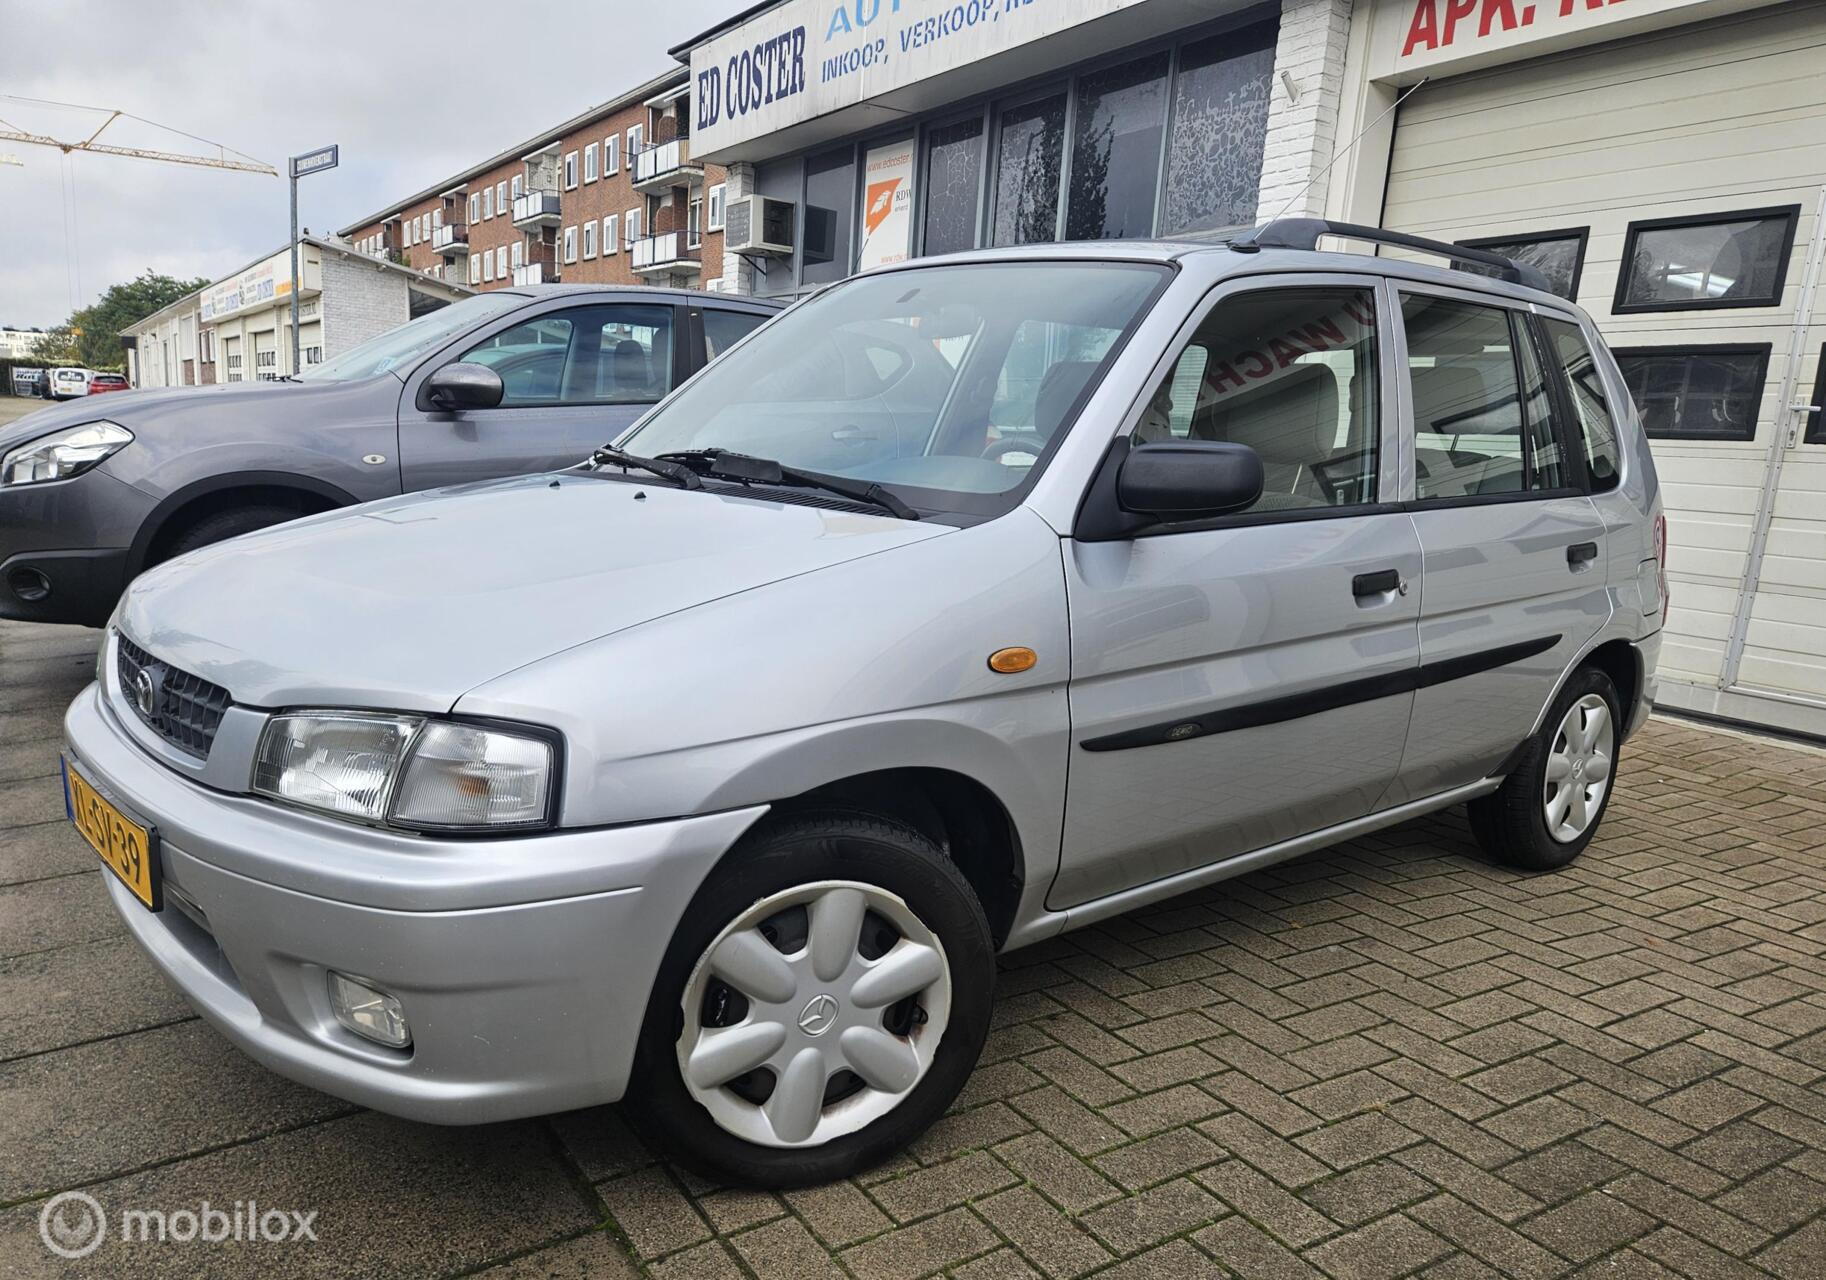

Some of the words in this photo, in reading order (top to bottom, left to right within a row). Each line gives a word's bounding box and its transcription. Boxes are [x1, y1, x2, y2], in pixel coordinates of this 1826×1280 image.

[822, 38, 888, 83] INKOOP,
[900, 0, 999, 52] VERKOOP,
[1401, 0, 1536, 57] APK.
[697, 66, 720, 131] ED
[726, 25, 805, 120] COSTER
[70, 772, 141, 885] XL-SV-39
